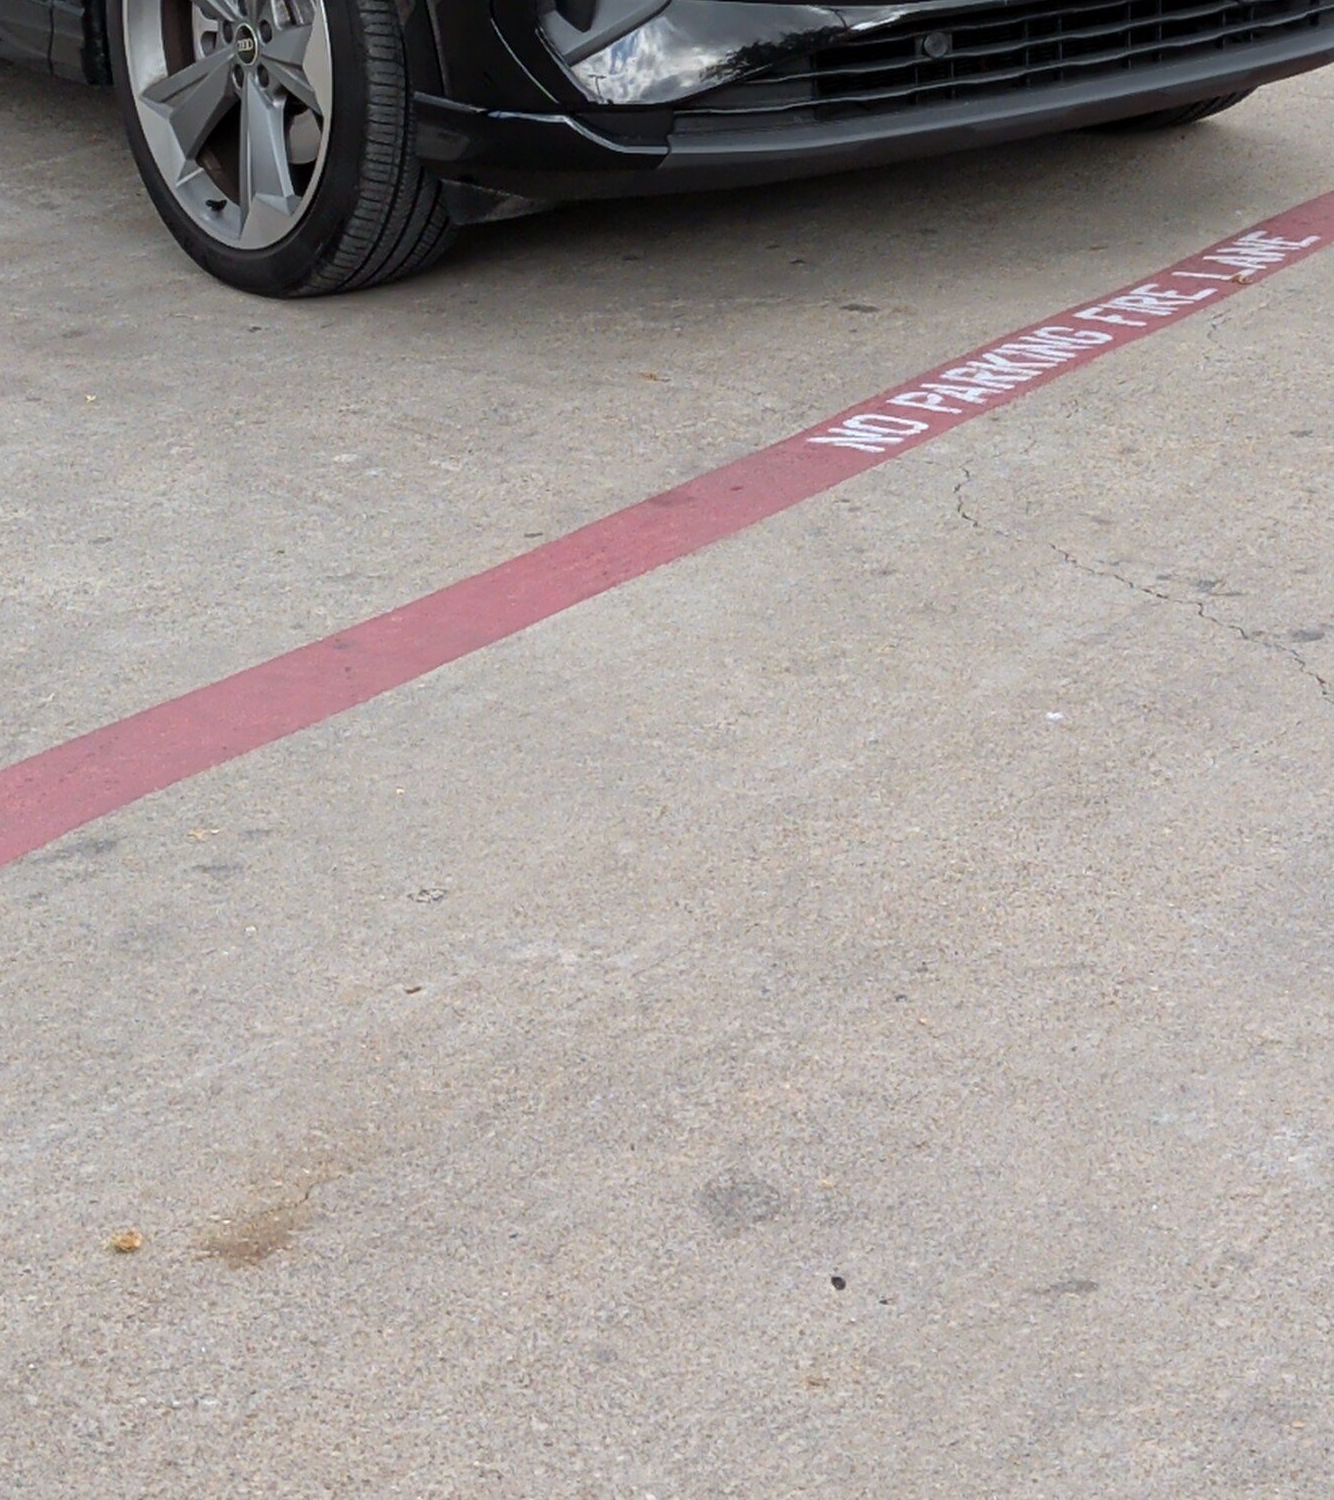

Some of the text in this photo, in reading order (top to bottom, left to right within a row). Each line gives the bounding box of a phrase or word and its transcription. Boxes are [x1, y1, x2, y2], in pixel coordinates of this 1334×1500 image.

[806, 230, 1321, 453] NO PARKING FIRE LANE
